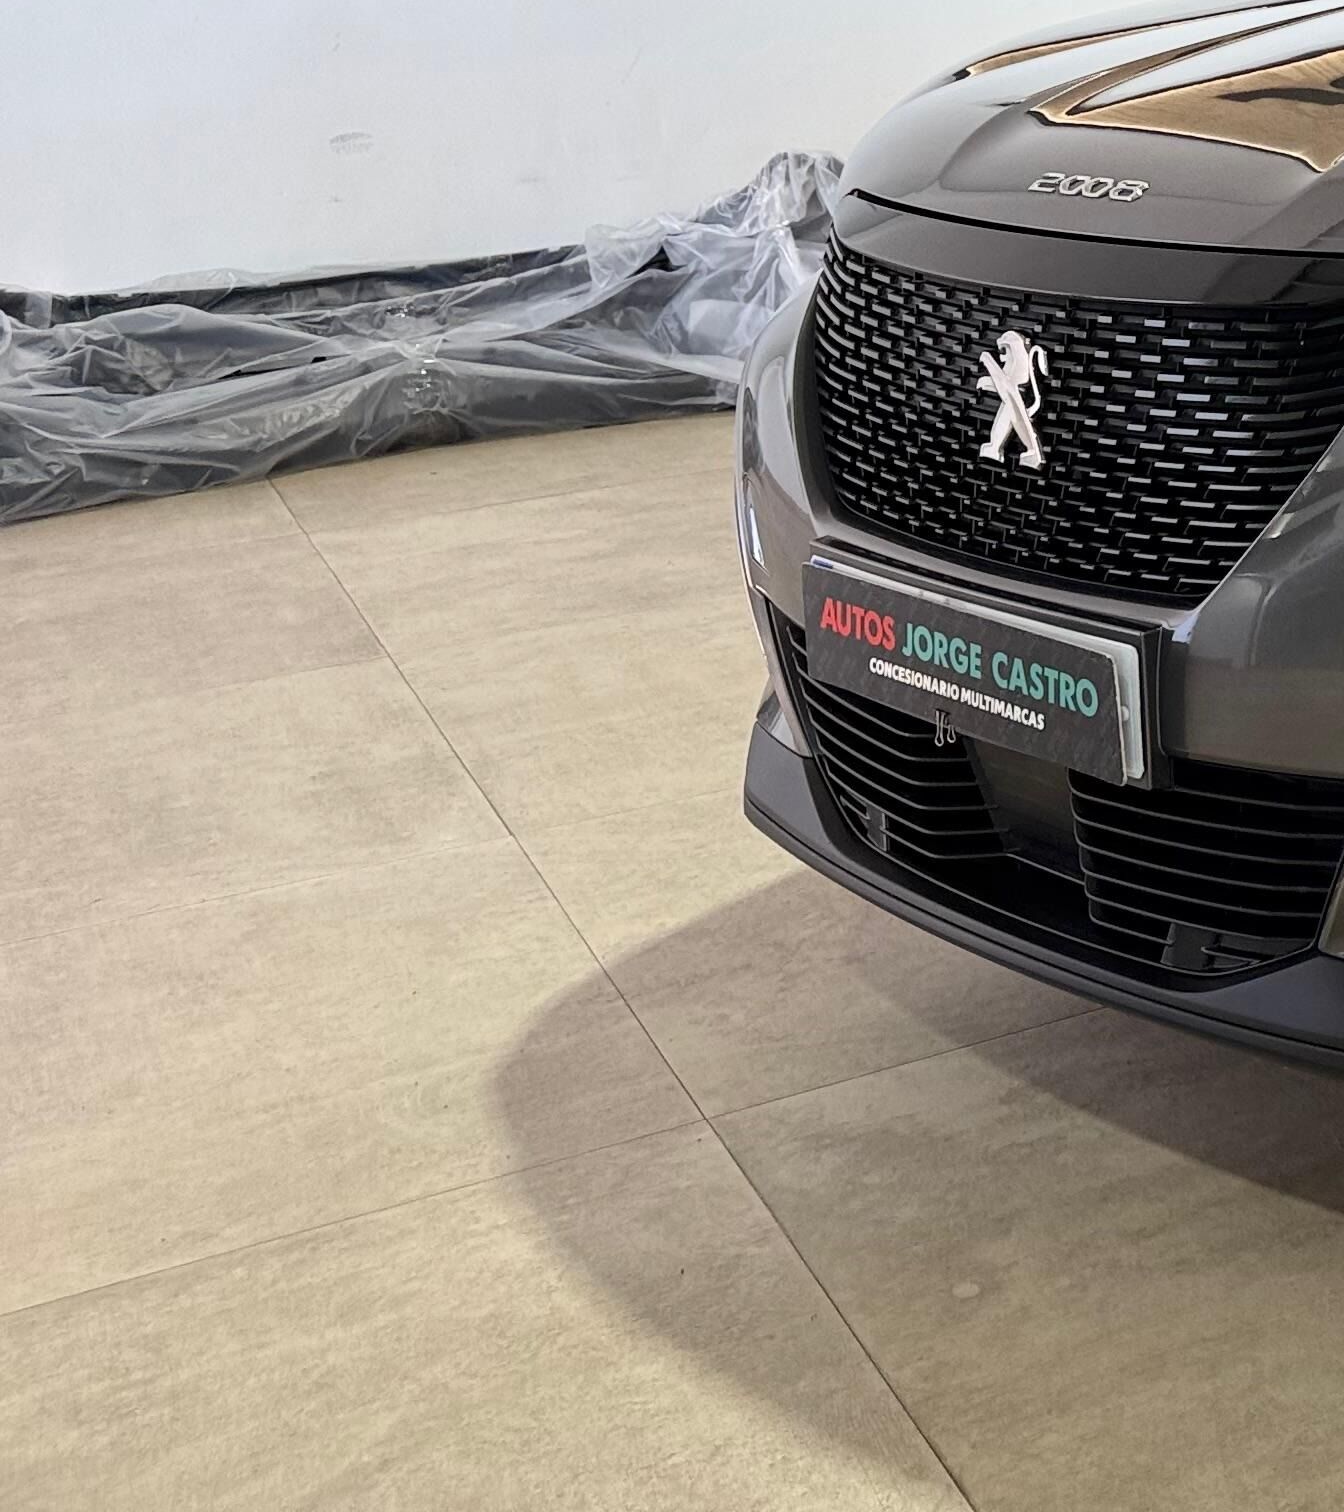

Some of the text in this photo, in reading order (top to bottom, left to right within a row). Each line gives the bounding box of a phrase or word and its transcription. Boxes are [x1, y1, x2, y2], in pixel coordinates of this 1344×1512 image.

[1028, 172, 1149, 202] 2008
[820, 597, 1099, 718] AUTOS JORGE CASTRO
[869, 657, 1045, 731] CONCESIONARIO MULTIMARCAS
